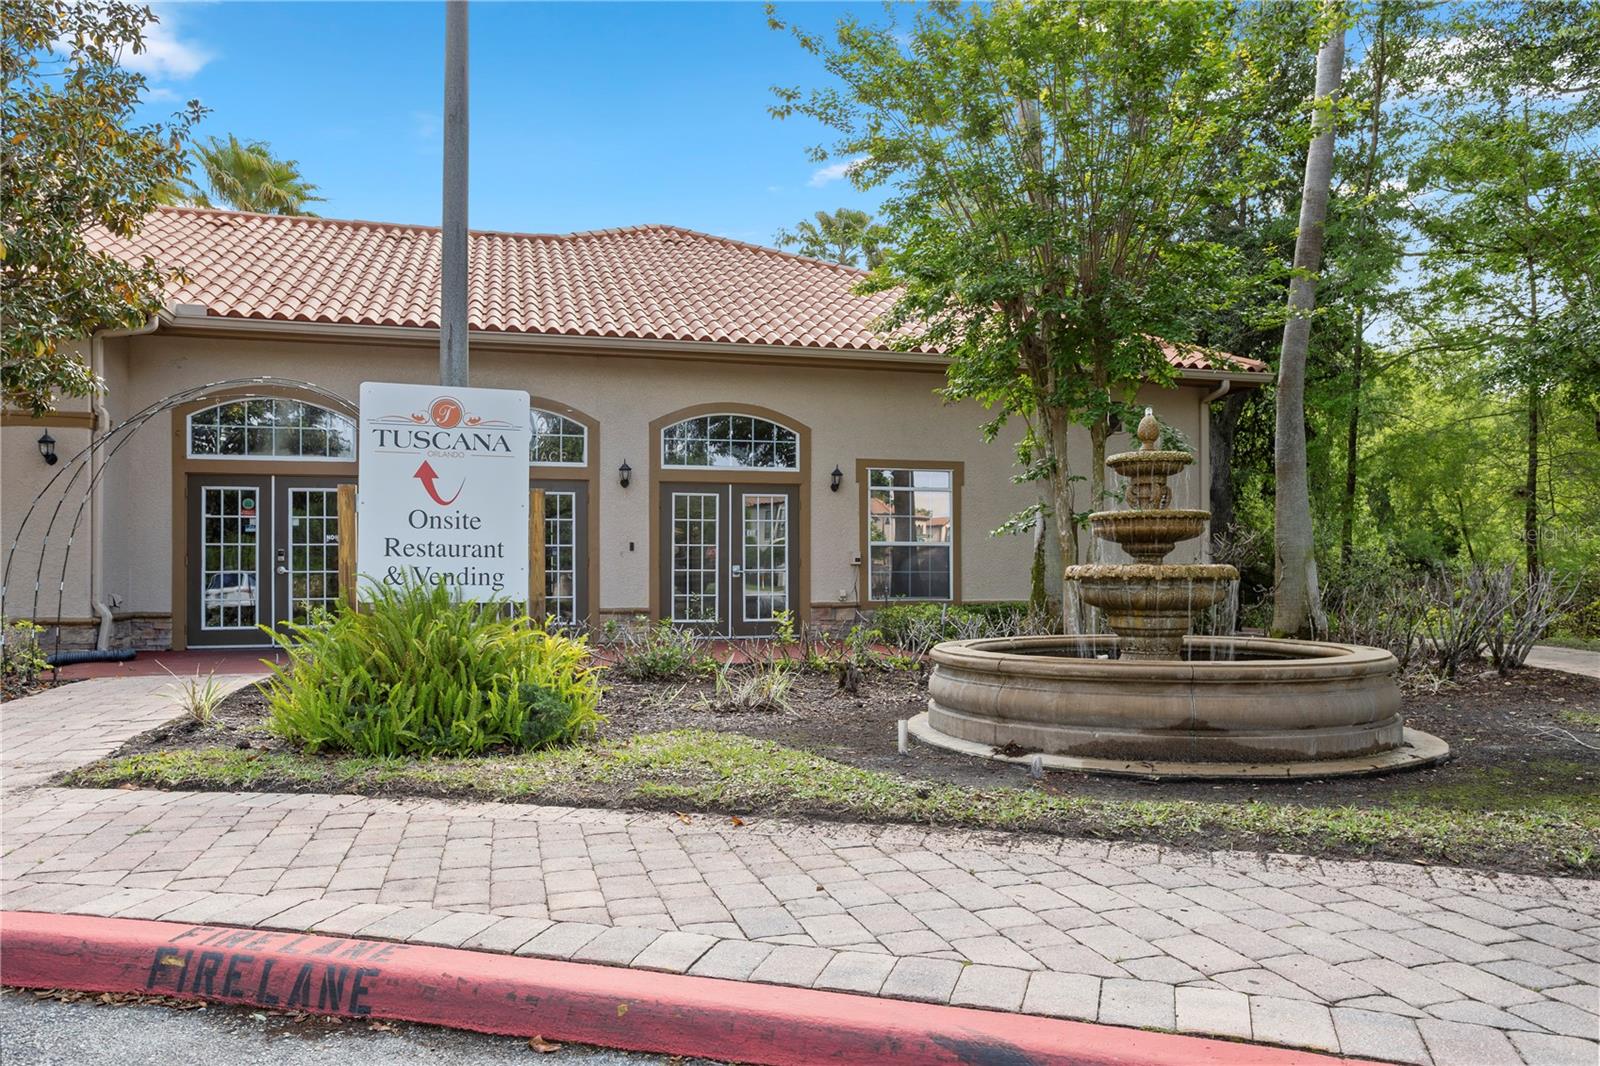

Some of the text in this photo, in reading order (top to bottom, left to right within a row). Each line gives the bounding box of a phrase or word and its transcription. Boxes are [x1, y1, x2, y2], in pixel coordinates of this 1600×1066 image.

[372, 429, 512, 452] TUSCANA
[426, 450, 465, 459] ORLANDO
[408, 509, 482, 530] Onsite
[384, 537, 504, 558] Restaurant
[383, 565, 505, 592] & Vending
[168, 926, 410, 963] FIRE LANE
[146, 946, 382, 1015] FIRE LANE
